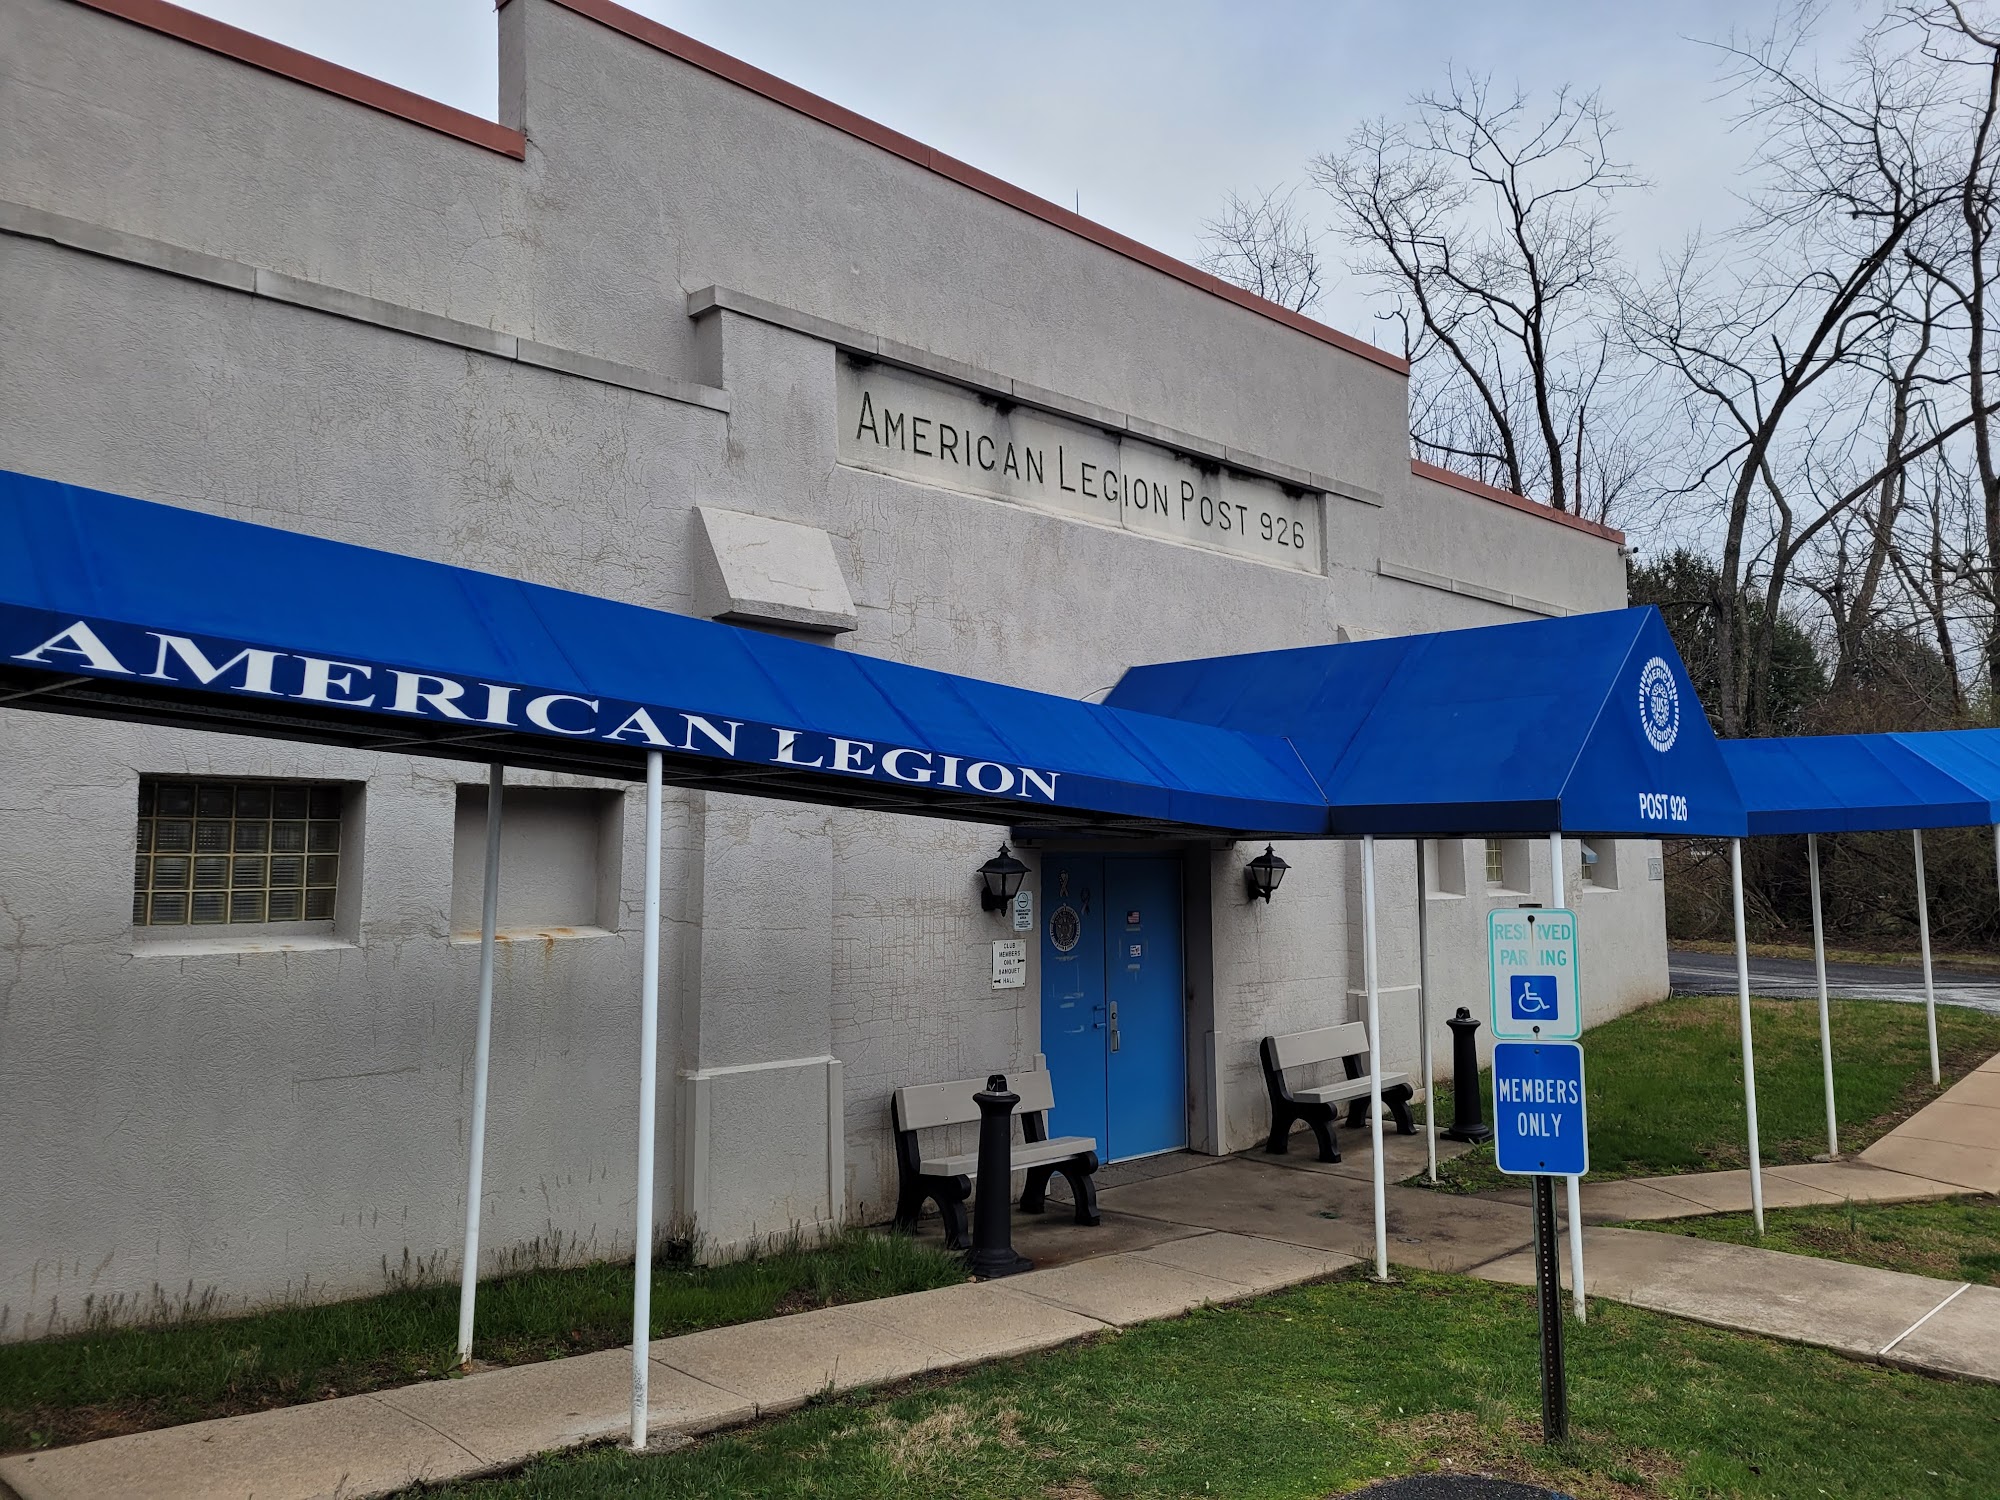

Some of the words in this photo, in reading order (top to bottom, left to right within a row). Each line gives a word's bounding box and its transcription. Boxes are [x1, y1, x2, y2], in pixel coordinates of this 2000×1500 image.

[856, 391, 1044, 484] AMERICAN
[1059, 445, 1168, 517] LEGION
[1181, 480, 1248, 536] POST
[1260, 512, 1305, 549] 926
[1644, 667, 1674, 700] AMERICAN
[10, 620, 744, 757] AMERICAN
[770, 727, 1061, 801] LEGION
[1649, 719, 1672, 741] LEGION
[1638, 792, 1669, 820] POST
[1670, 795, 1688, 822] 926
[1494, 923, 1571, 940] RESRVED
[998, 950, 1021, 958] MEMBERS
[1500, 949, 1567, 966] PARING
[998, 967, 1020, 976] BANQUET
[1499, 1078, 1579, 1105] MEMBERS
[1517, 1112, 1562, 1138] ONLY
